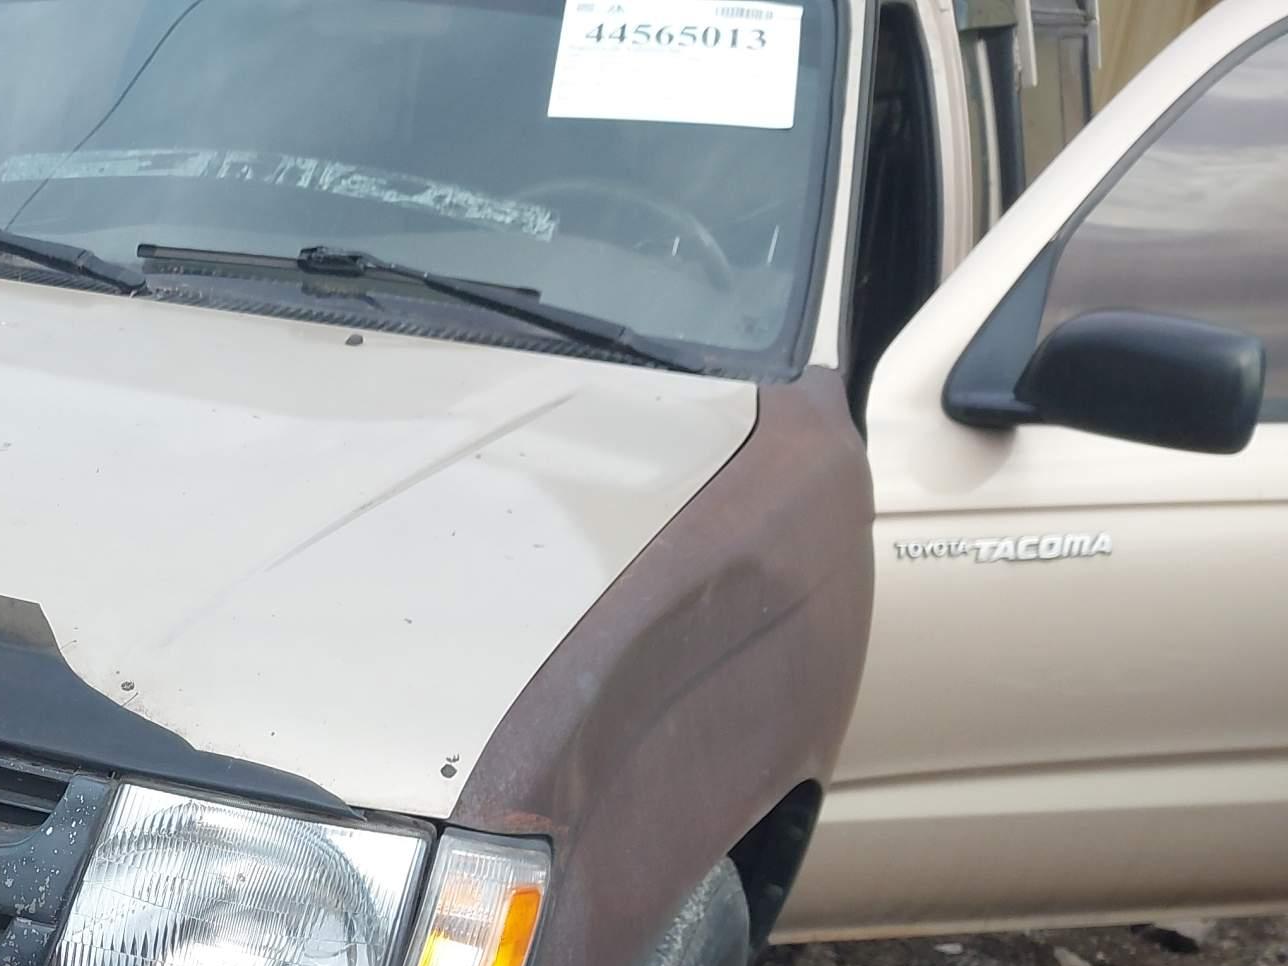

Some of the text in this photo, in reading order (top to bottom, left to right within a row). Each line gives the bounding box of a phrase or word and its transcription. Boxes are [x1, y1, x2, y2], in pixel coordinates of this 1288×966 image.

[585, 22, 768, 50] 44565013
[895, 531, 1113, 563] TOYOTA TACOMA
